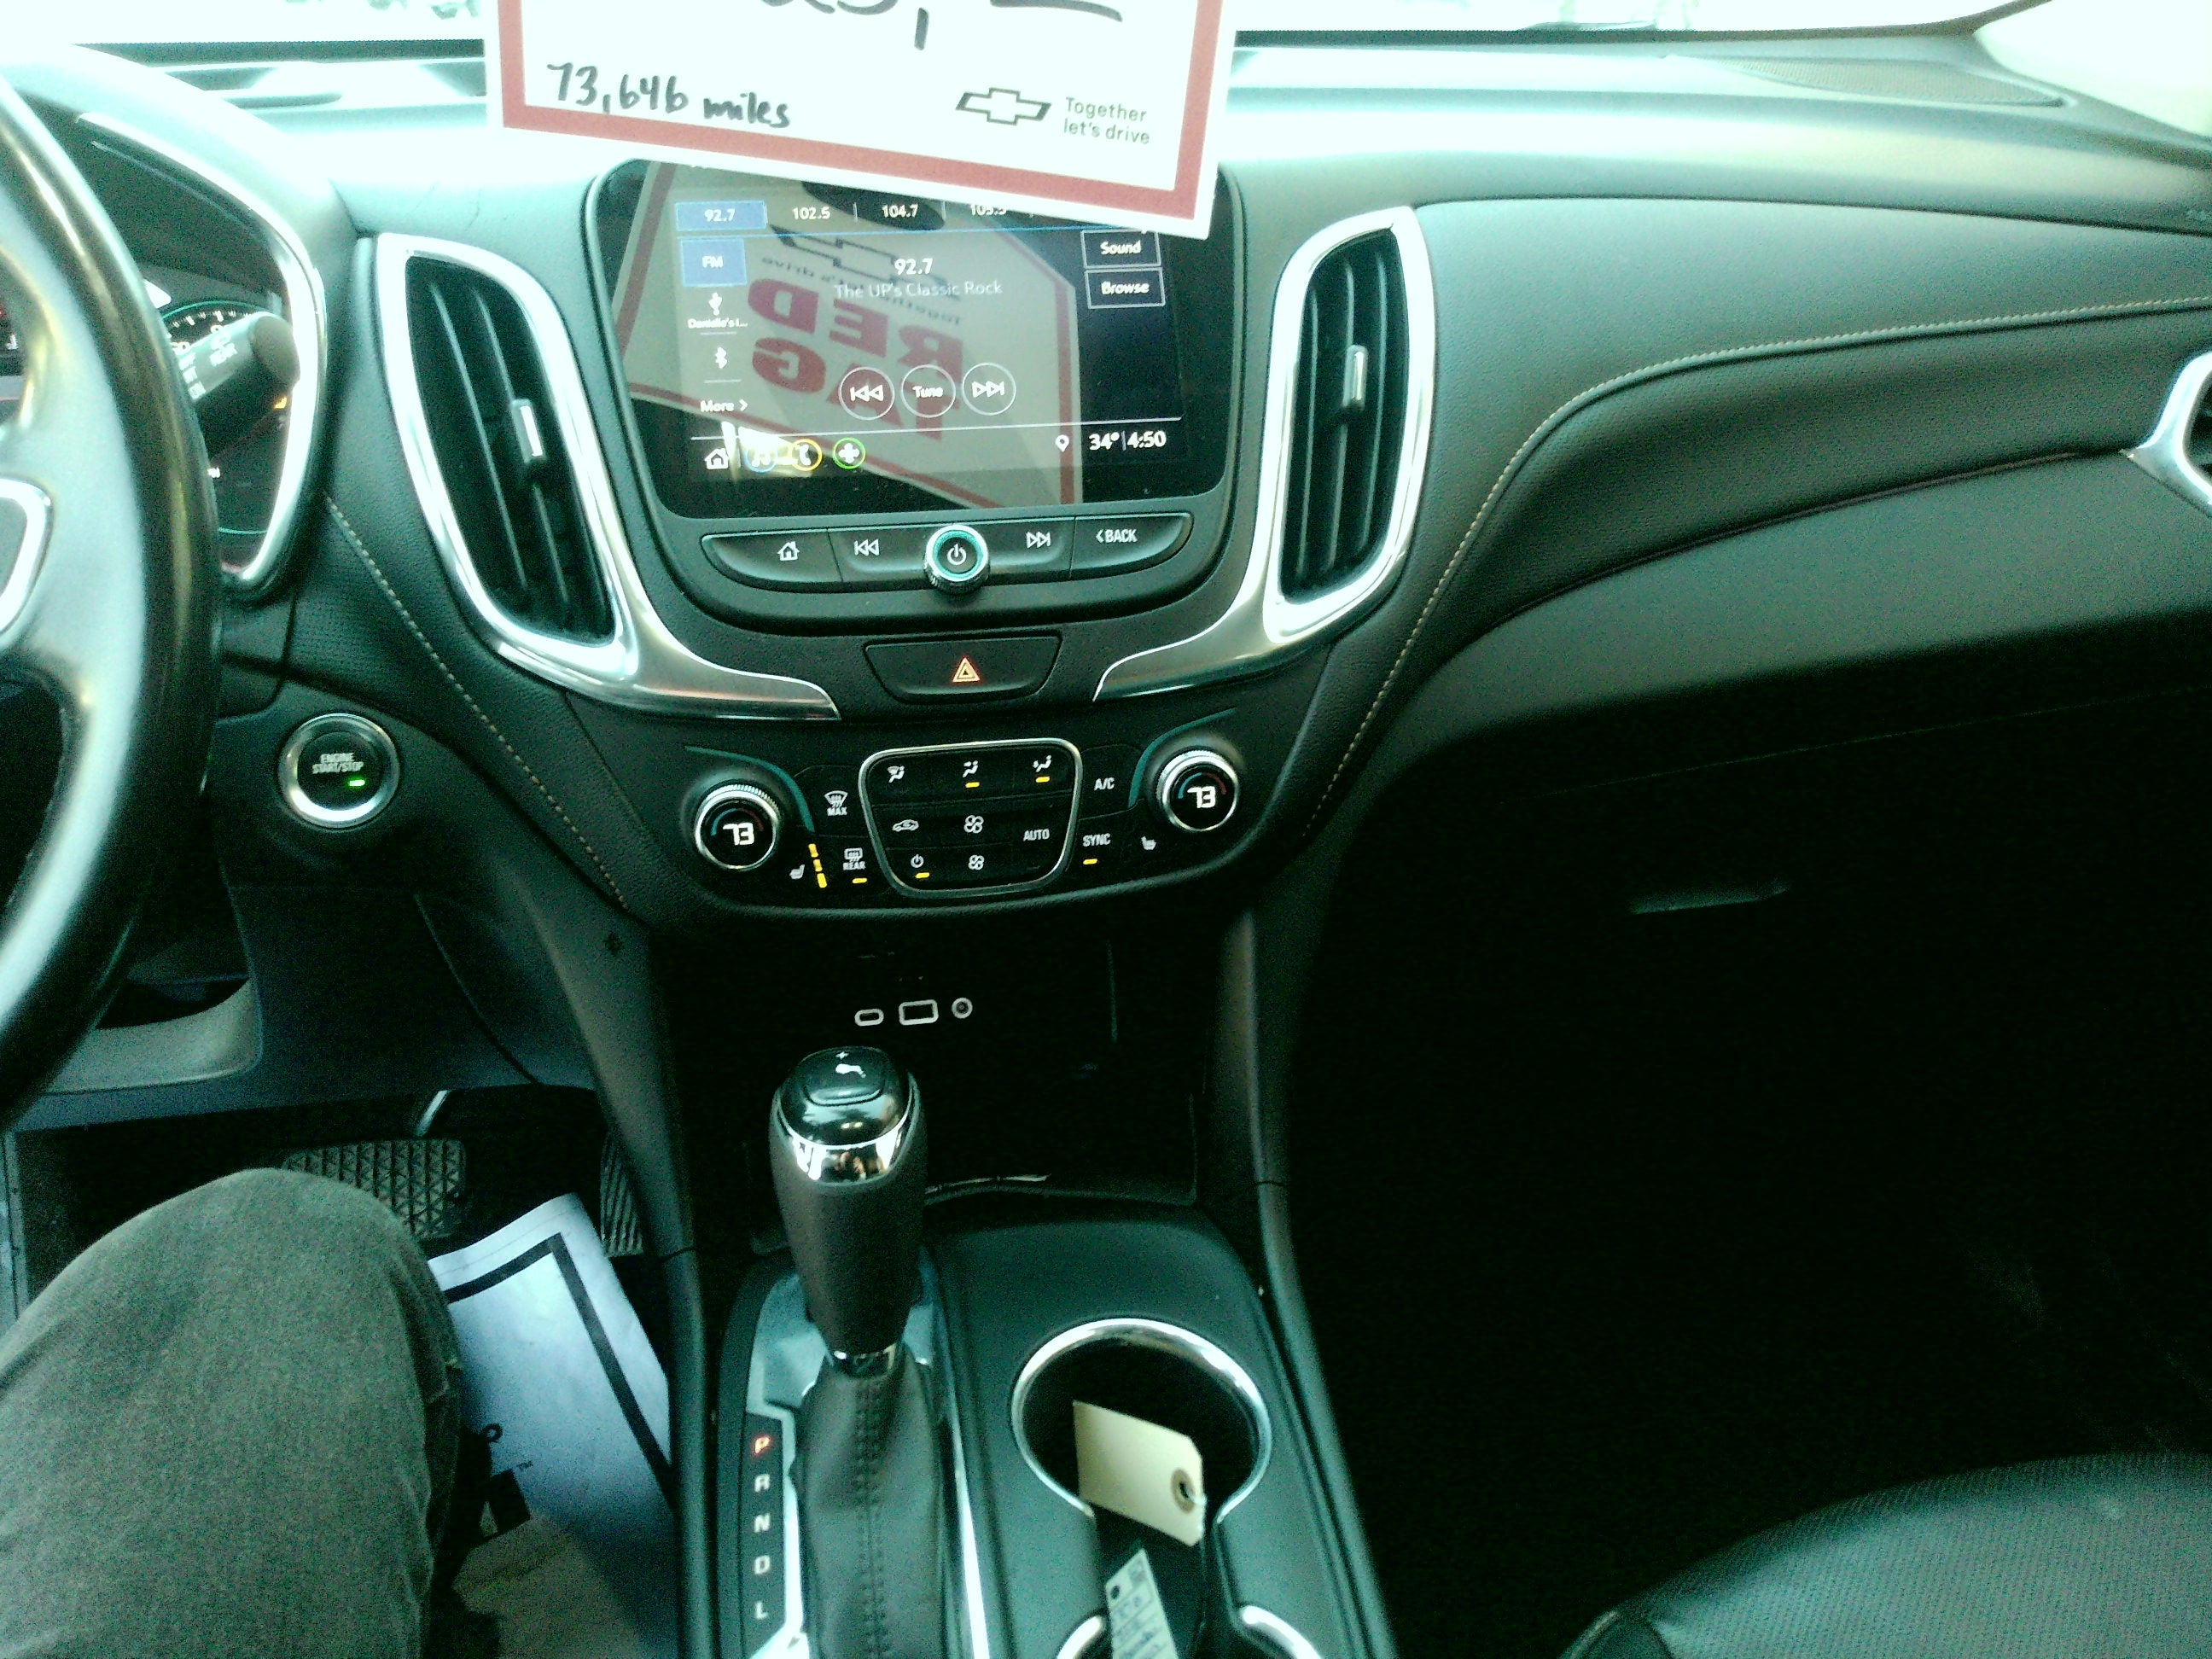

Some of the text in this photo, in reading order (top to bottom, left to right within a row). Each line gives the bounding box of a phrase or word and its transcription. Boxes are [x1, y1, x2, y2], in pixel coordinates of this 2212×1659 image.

[547, 62, 790, 128] 73,646 miles
[1066, 96, 1147, 122] Together
[1064, 117, 1150, 144] let's drive
[704, 208, 736, 222] 92.7
[793, 207, 831, 220] 102.5
[882, 203, 918, 218] 104.7
[1100, 240, 1142, 255] Sound
[701, 255, 725, 269] FM
[894, 258, 933, 276] 92.7
[835, 279, 1004, 299] The UP's Classic Rock
[1102, 281, 1150, 296] Browse
[912, 385, 944, 399] Tune
[700, 399, 735, 413] More
[1126, 430, 1167, 449] 4:50
[1104, 528, 1138, 544] BACK
[1093, 777, 1115, 791] A/C
[826, 806, 848, 817] MAX
[1023, 828, 1051, 842] AUTO
[1082, 832, 1111, 847] SYNC
[842, 860, 866, 871] REAR
[754, 1436, 771, 1454] P
[754, 1473, 771, 1493] R
[754, 1512, 771, 1534] N
[754, 1554, 771, 1575] D
[754, 1601, 769, 1620] L
